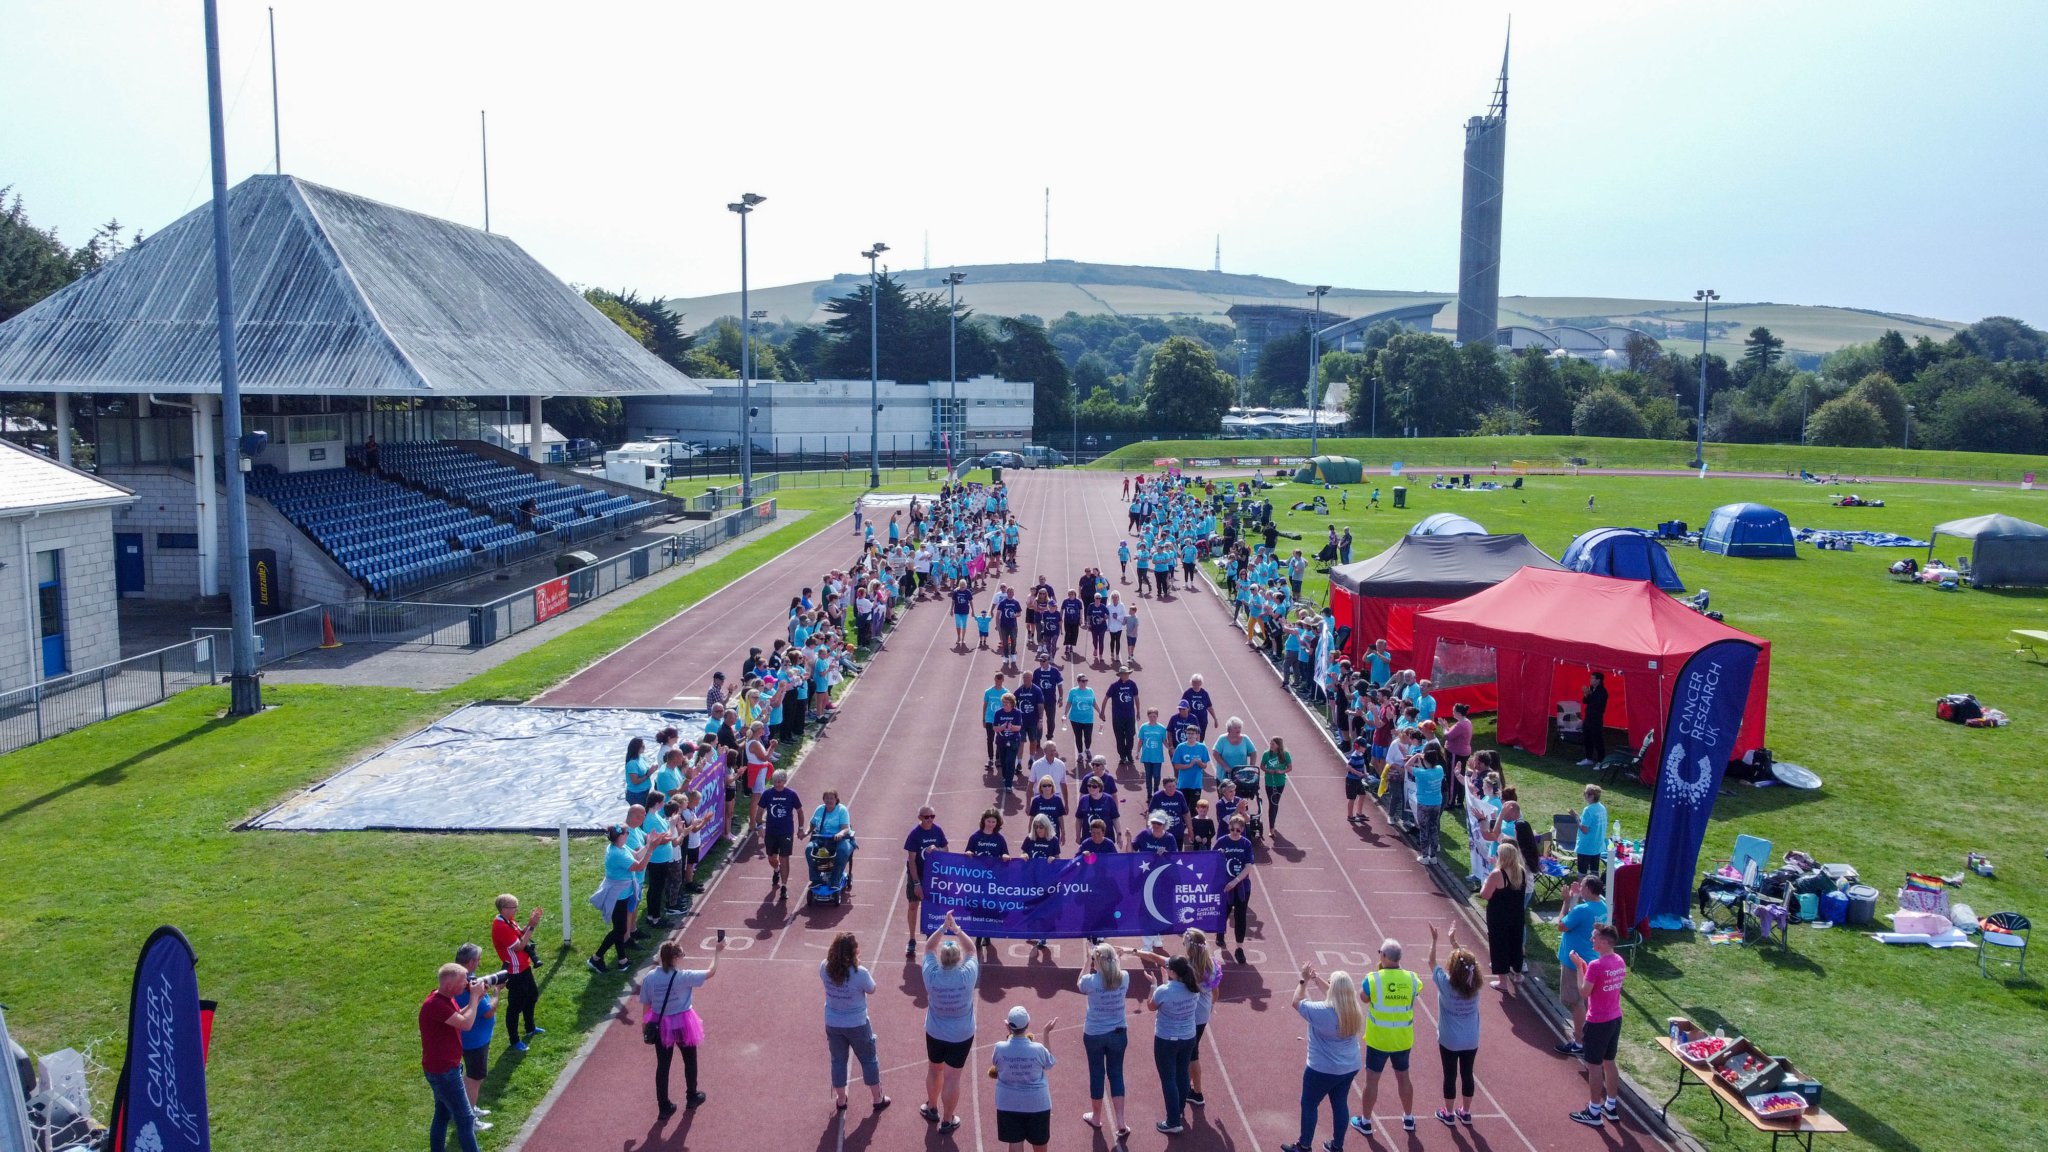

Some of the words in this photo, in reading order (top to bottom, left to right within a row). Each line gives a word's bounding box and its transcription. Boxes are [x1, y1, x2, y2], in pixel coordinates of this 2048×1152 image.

[1678, 670, 1703, 735] CANCER
[1690, 661, 1722, 741] RESEARCH
[1704, 726, 1721, 747] UK
[977, 840, 998, 848] Survivor
[932, 861, 996, 880] Survivors.
[931, 877, 953, 891] For
[954, 882, 984, 895] you.
[988, 883, 1044, 896] Because
[1047, 882, 1061, 894] of
[1063, 882, 1093, 896] you.
[1175, 884, 1209, 894] RELAY
[930, 892, 978, 908] Thanks
[982, 899, 996, 909] to
[999, 901, 1028, 912] you.
[1175, 894, 1196, 904] FOR
[1199, 893, 1220, 903] LIFE
[147, 985, 163, 1109] CANCER
[160, 973, 181, 1129] RESEARCH
[183, 1103, 200, 1146] UK
